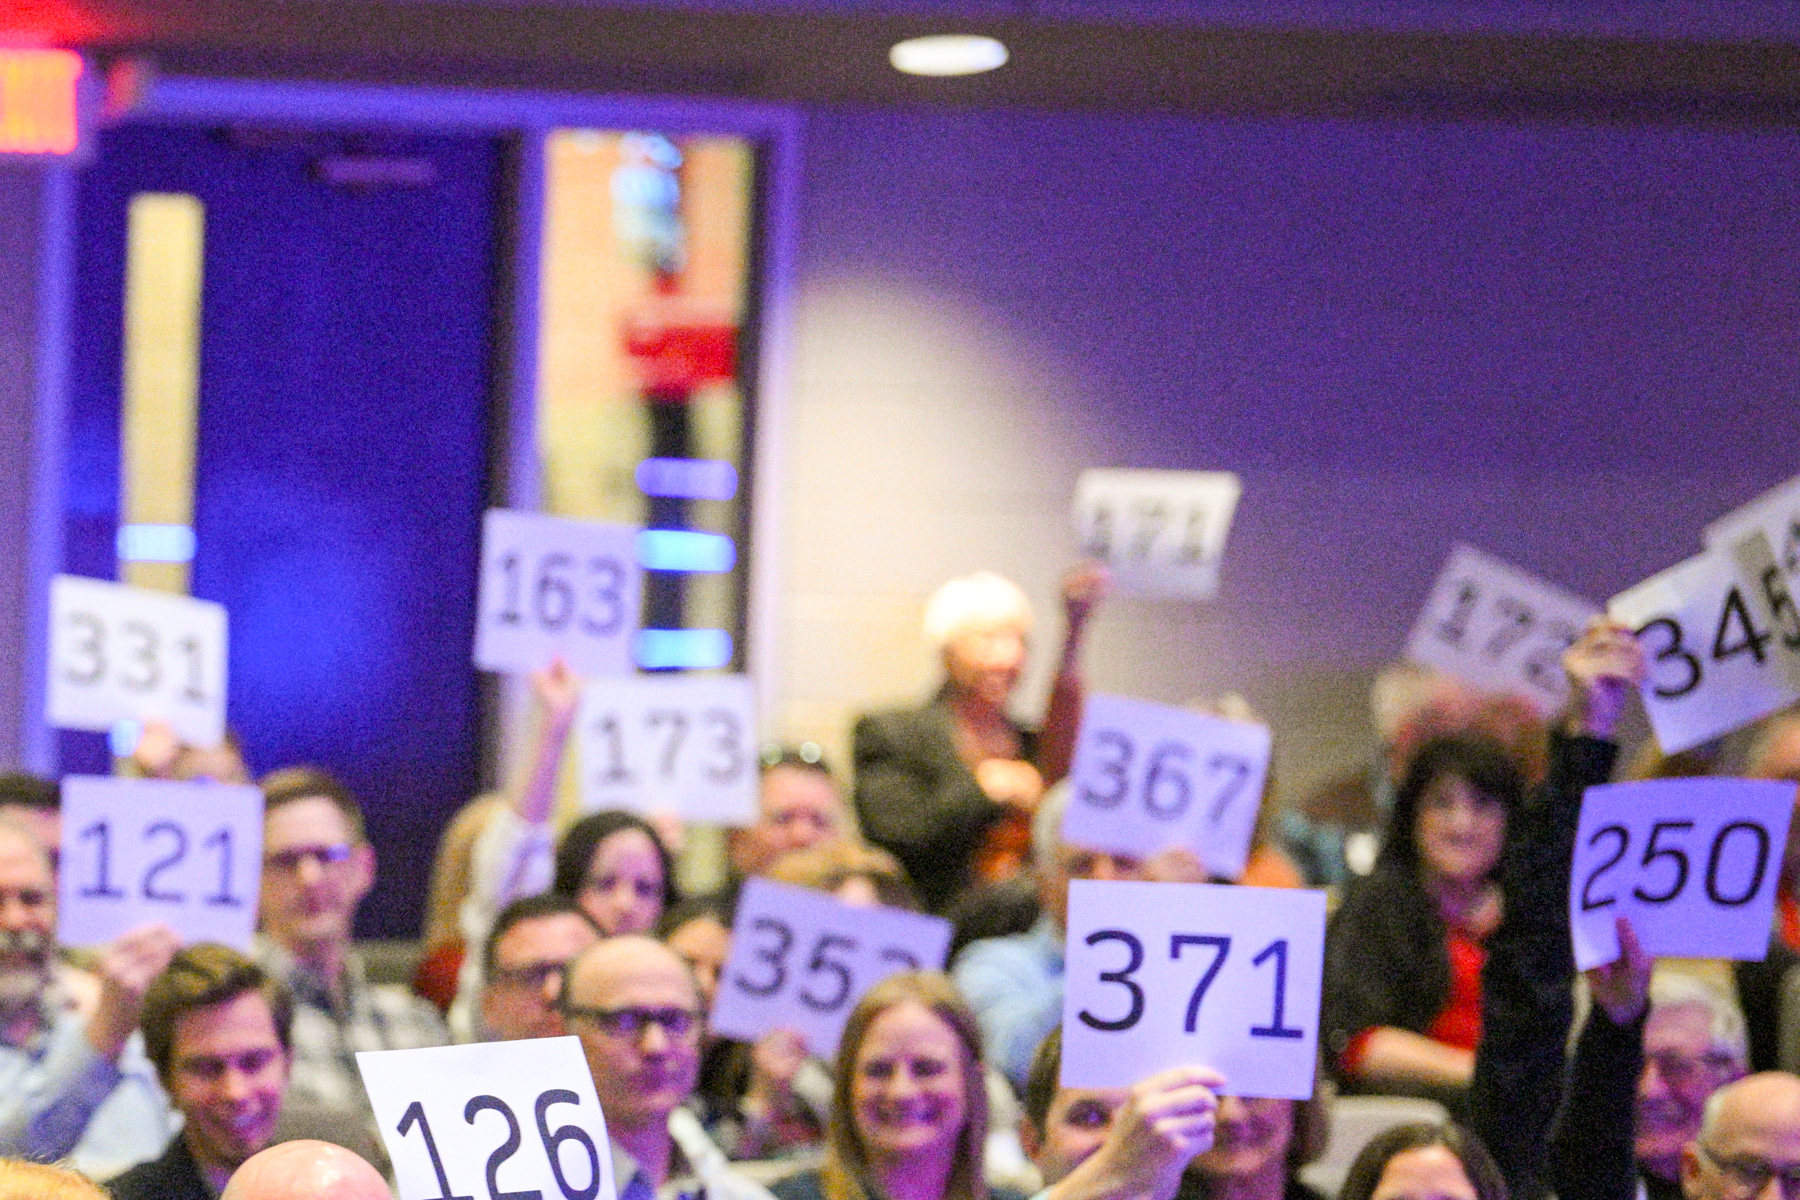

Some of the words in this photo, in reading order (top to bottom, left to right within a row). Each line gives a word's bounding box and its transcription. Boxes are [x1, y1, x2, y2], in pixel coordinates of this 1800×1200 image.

[487, 551, 628, 636] 163
[64, 610, 208, 705] 331
[590, 709, 752, 785] 173
[1080, 729, 1256, 830] 367
[77, 822, 244, 906] 121
[1581, 820, 1773, 911] 250
[732, 915, 922, 1014] 35
[1076, 928, 1306, 1039] 371
